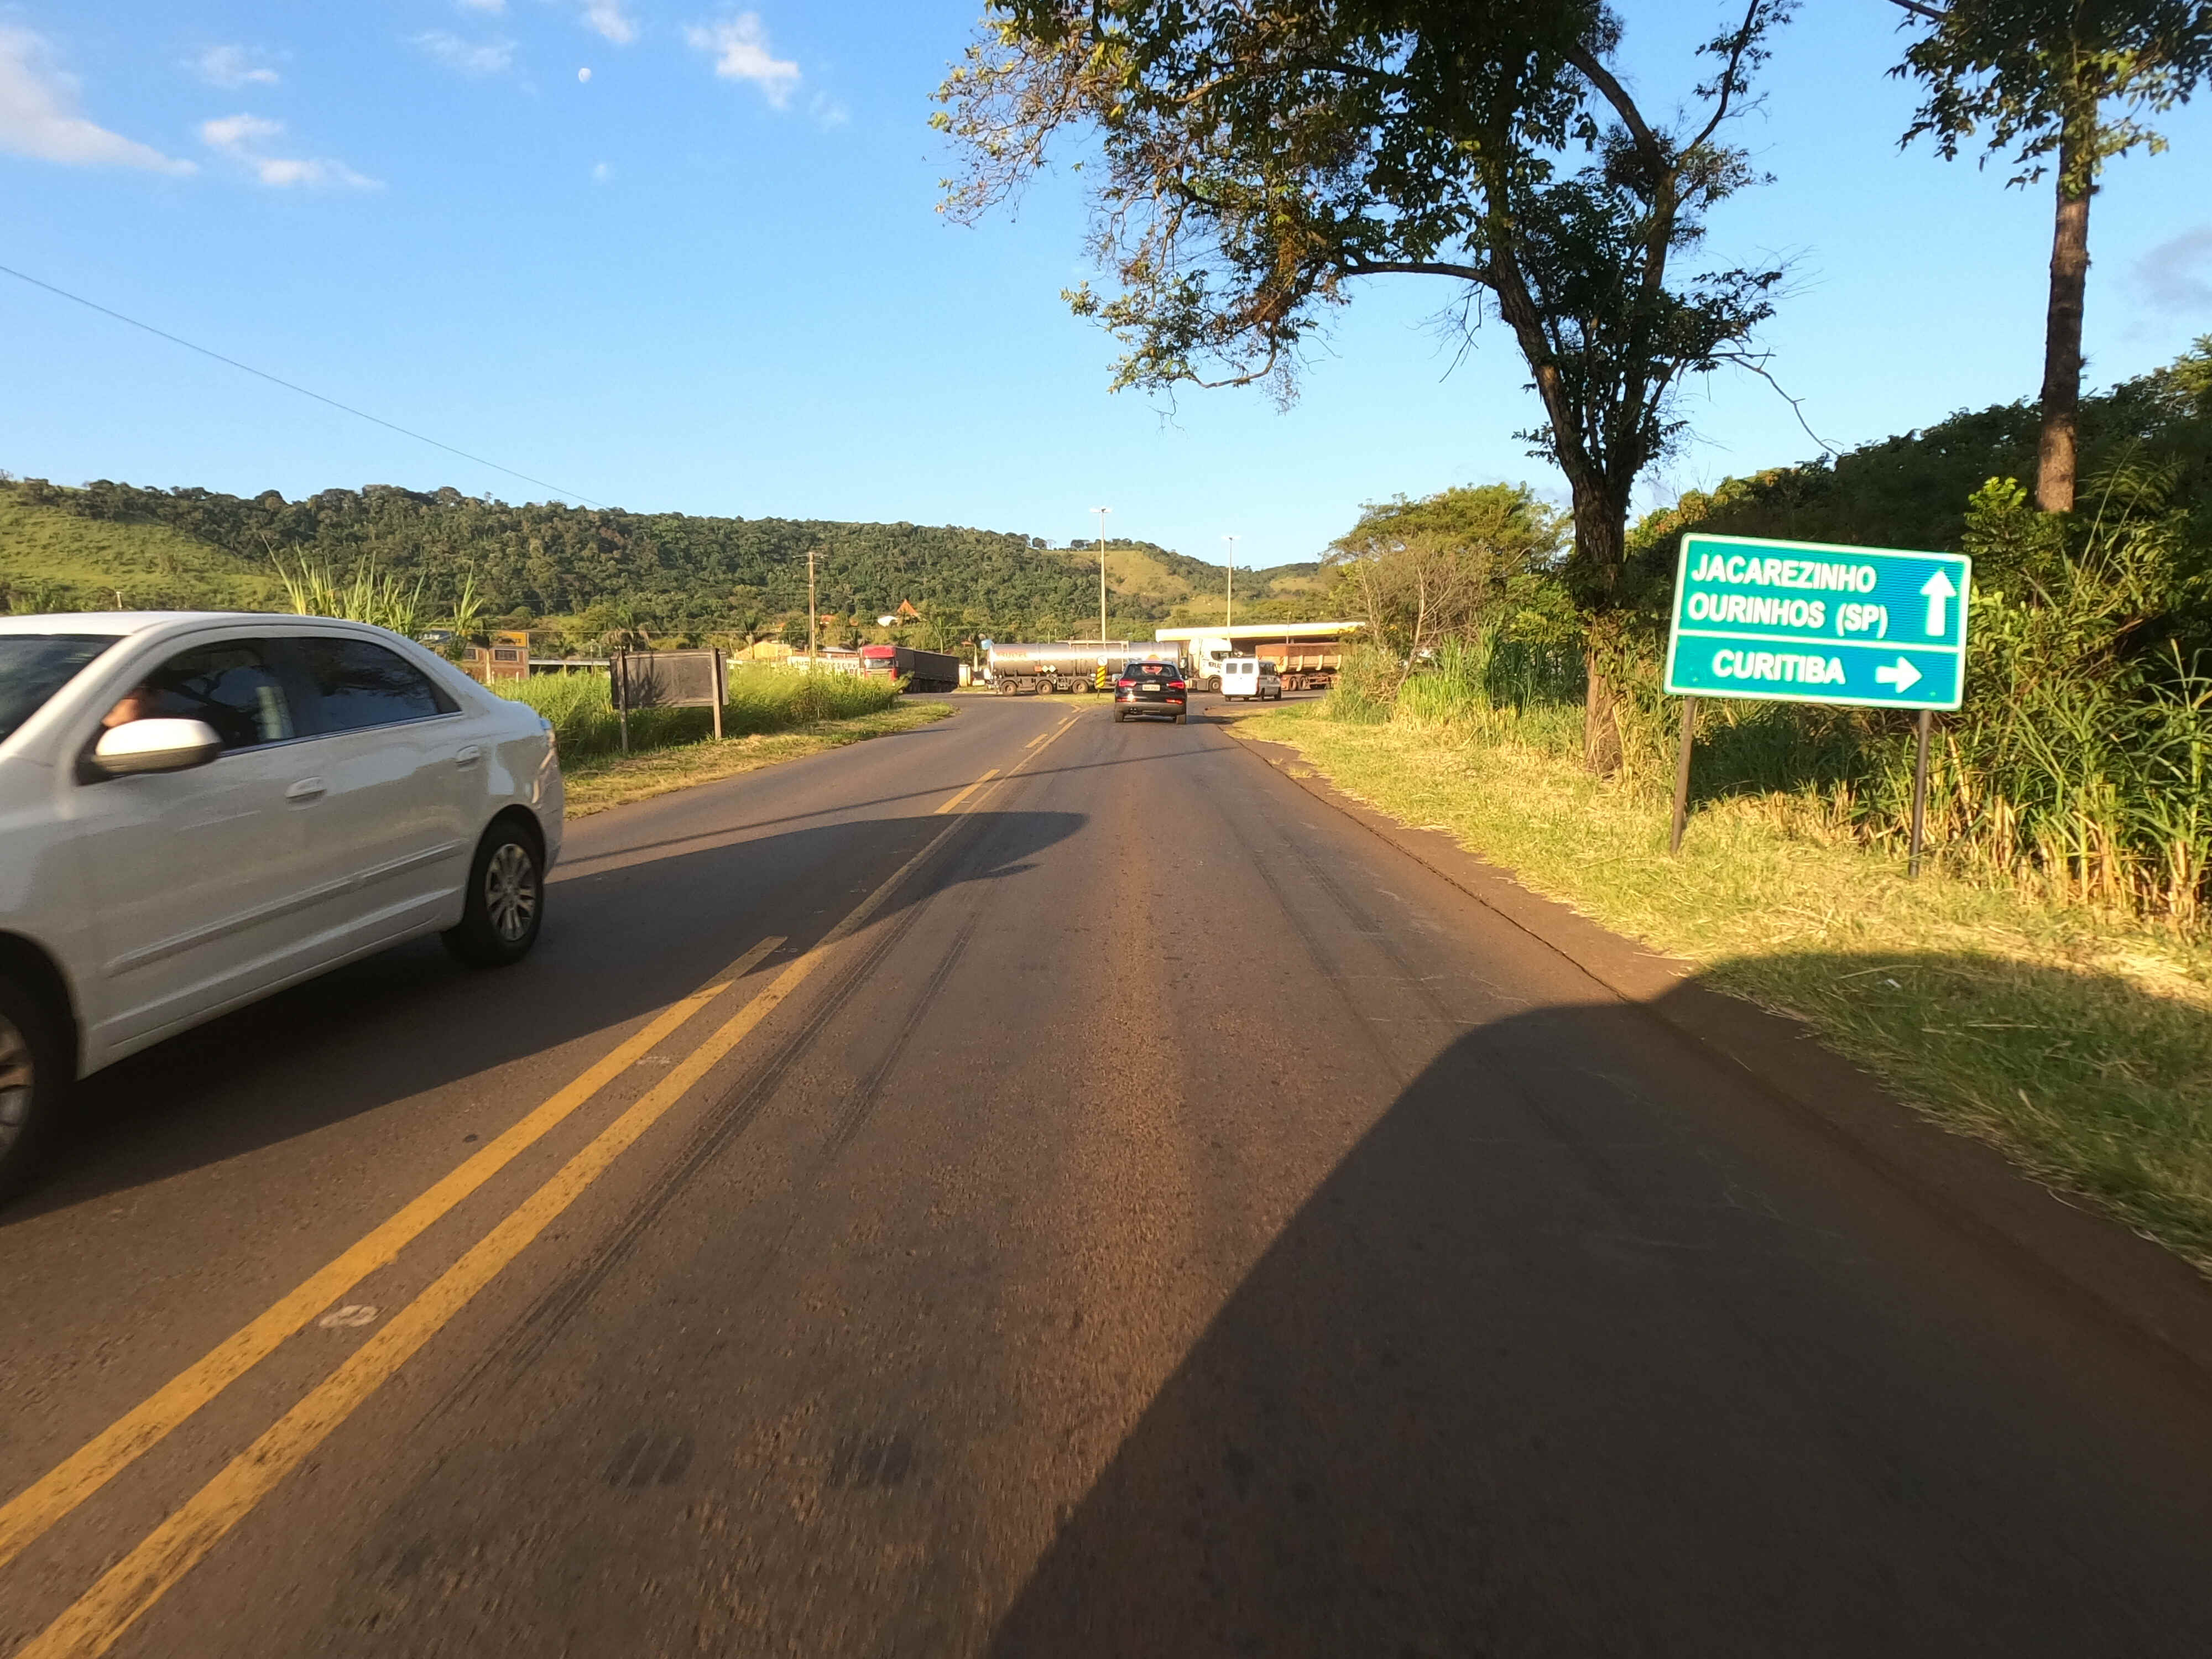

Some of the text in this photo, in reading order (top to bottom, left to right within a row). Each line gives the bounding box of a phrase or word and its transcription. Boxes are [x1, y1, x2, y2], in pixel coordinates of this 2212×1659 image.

[1691, 554, 1876, 593] JACAREZINHO
[1687, 592, 1888, 639] OURINHOS (SP)
[1712, 649, 1846, 685] CURITIBA
